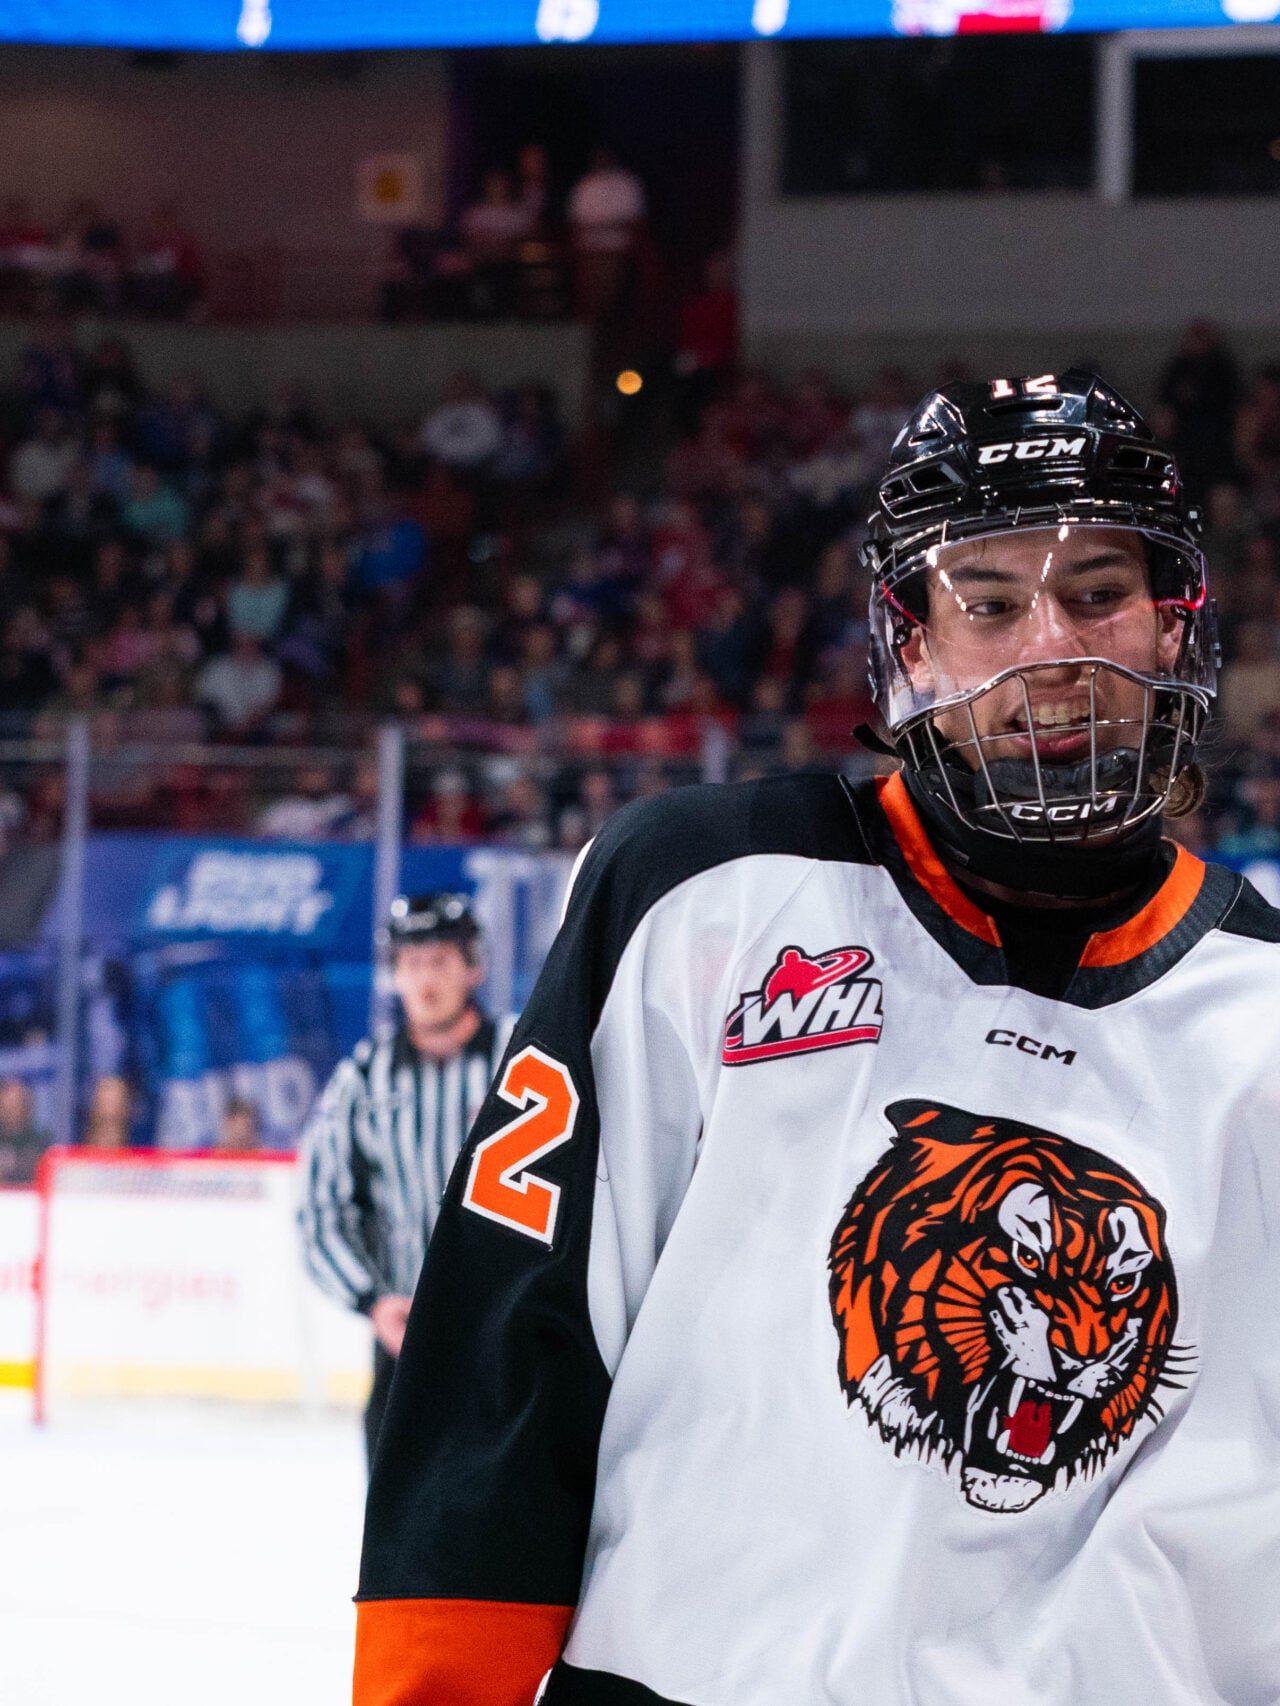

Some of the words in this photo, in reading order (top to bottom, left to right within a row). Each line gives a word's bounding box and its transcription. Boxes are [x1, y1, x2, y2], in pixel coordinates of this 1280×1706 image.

[978, 437, 1087, 465] CCM
[1010, 796, 1118, 821] CCM
[742, 981, 883, 1047] WHL
[985, 1029, 1078, 1066] CCM
[462, 1044, 581, 1245] 2
